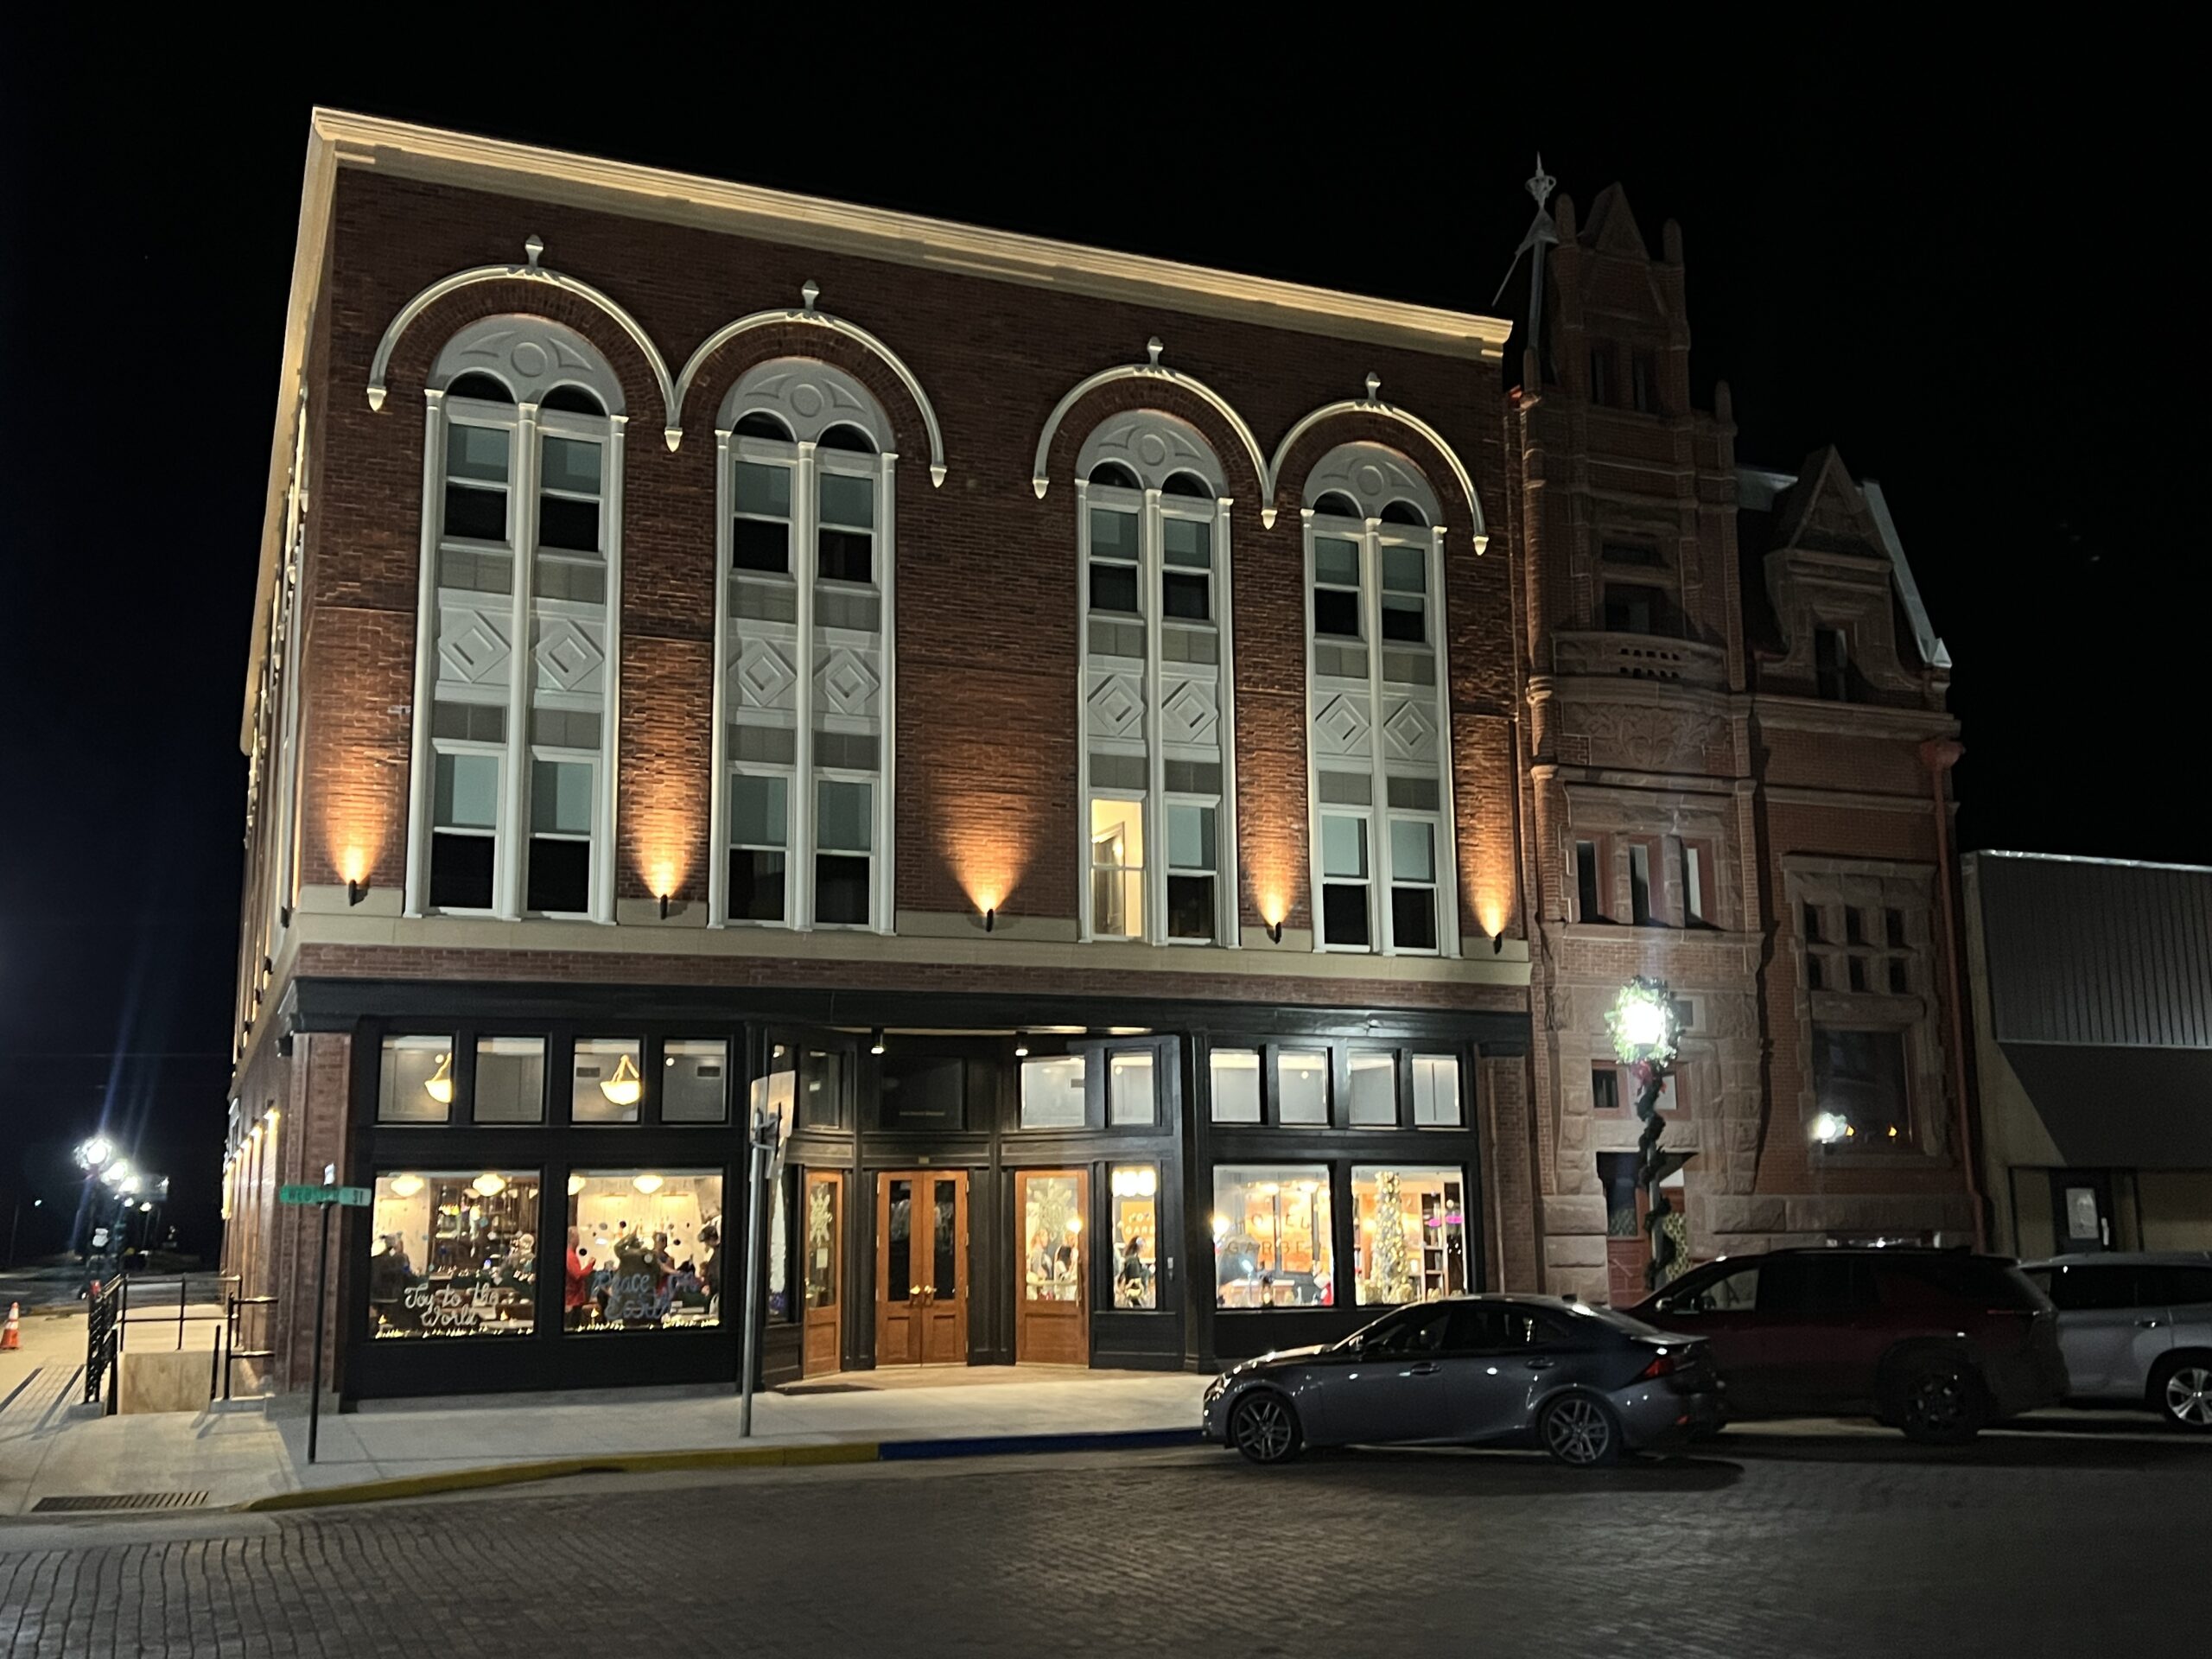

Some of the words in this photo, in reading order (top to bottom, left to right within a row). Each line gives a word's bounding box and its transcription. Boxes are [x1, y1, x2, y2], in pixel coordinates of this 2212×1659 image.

[1227, 1239, 1318, 1256] GARBE
[404, 1282, 435, 1310] Joy
[435, 1283, 462, 1307] to
[466, 1281, 499, 1306] the
[420, 1304, 480, 1327] World
